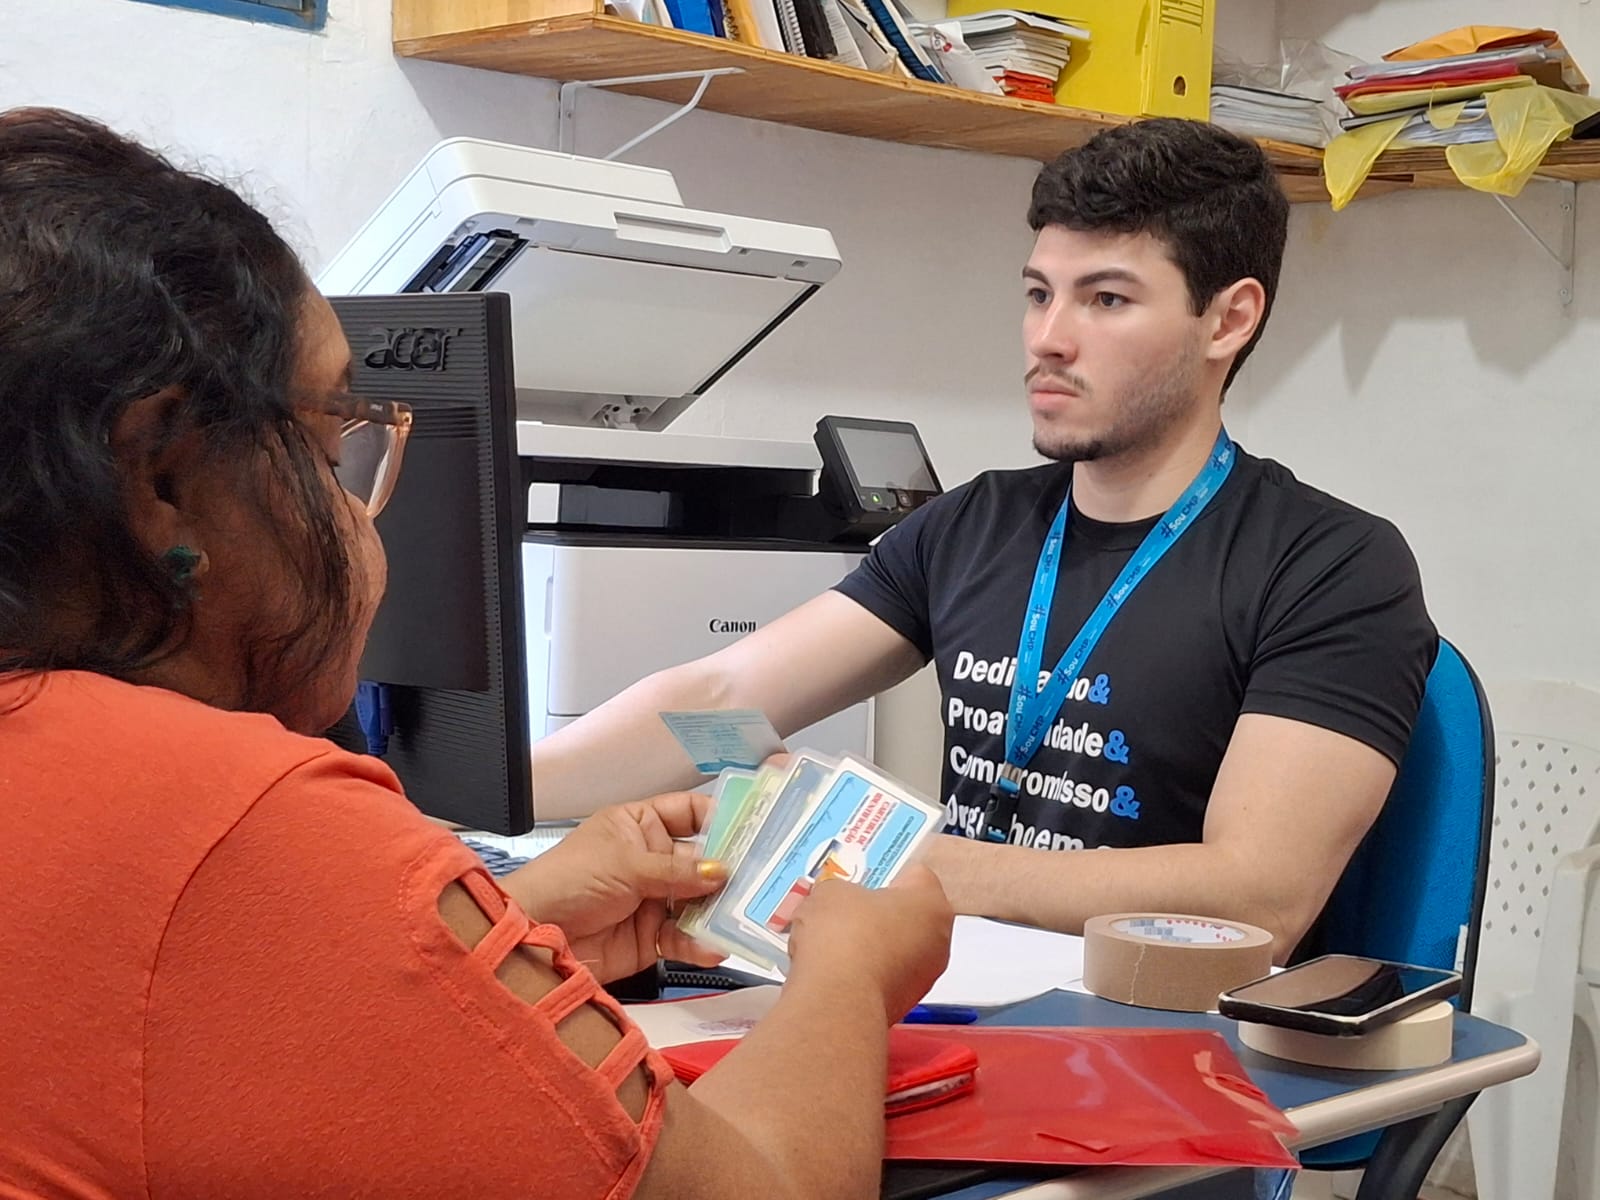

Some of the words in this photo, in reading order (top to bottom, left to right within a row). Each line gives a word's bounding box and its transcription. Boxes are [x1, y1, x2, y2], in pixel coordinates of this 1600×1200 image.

[364, 327, 463, 371] acer
[709, 618, 757, 633] Canon
[844, 792, 883, 845] IDENTIFICAÇÃO
[863, 800, 890, 835] CARTEIRA
